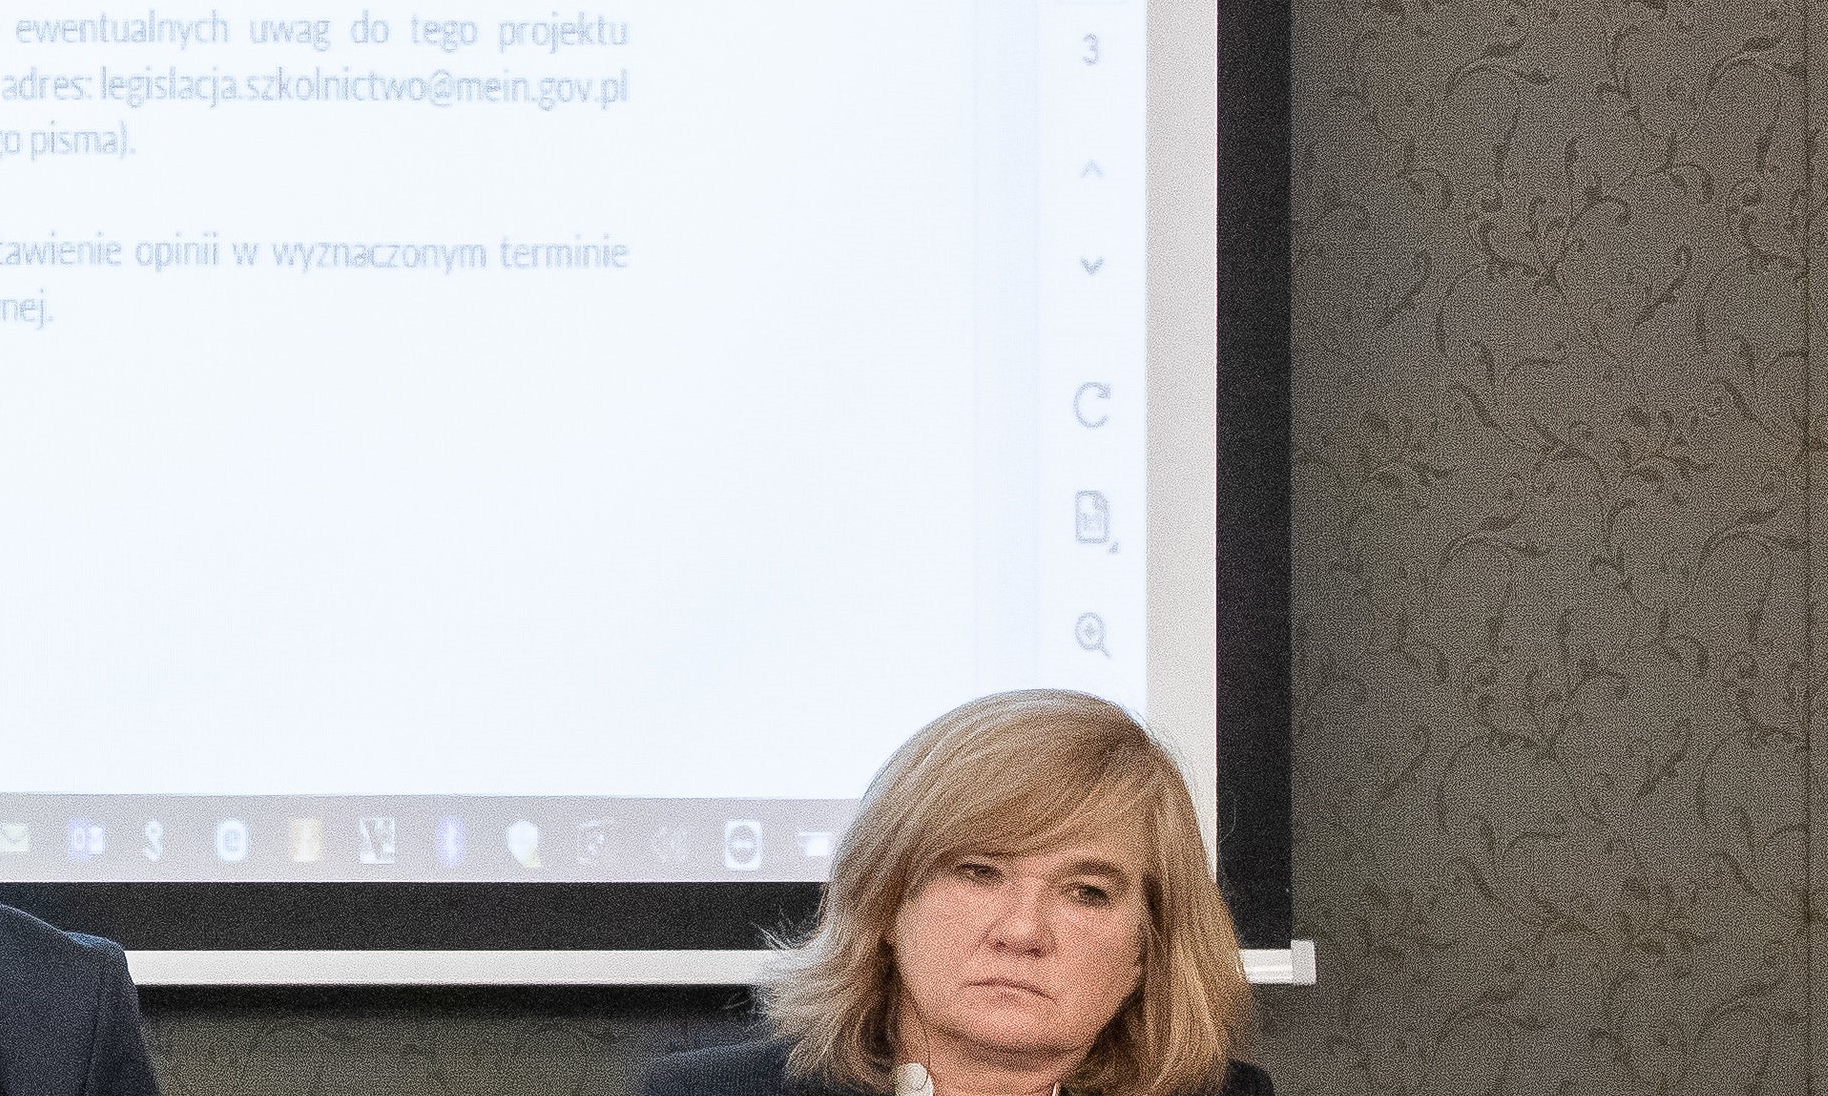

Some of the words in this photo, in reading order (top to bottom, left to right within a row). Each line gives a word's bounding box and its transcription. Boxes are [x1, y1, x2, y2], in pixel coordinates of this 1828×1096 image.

[15, 9, 230, 51] ewentualnych
[249, 18, 331, 53] uwag
[350, 9, 391, 45] do
[410, 15, 479, 54] tego
[498, 11, 629, 55] projektu
[1082, 33, 1100, 66] 3
[1, 66, 93, 100] adres:
[101, 66, 629, 112] legislacja.szkolnictwo@mein.gov.pl
[30, 120, 136, 162] pisma).
[134, 231, 220, 273] opinii
[231, 242, 260, 267] w
[271, 241, 488, 275] wyznaczonym
[499, 233, 630, 270] terminie
